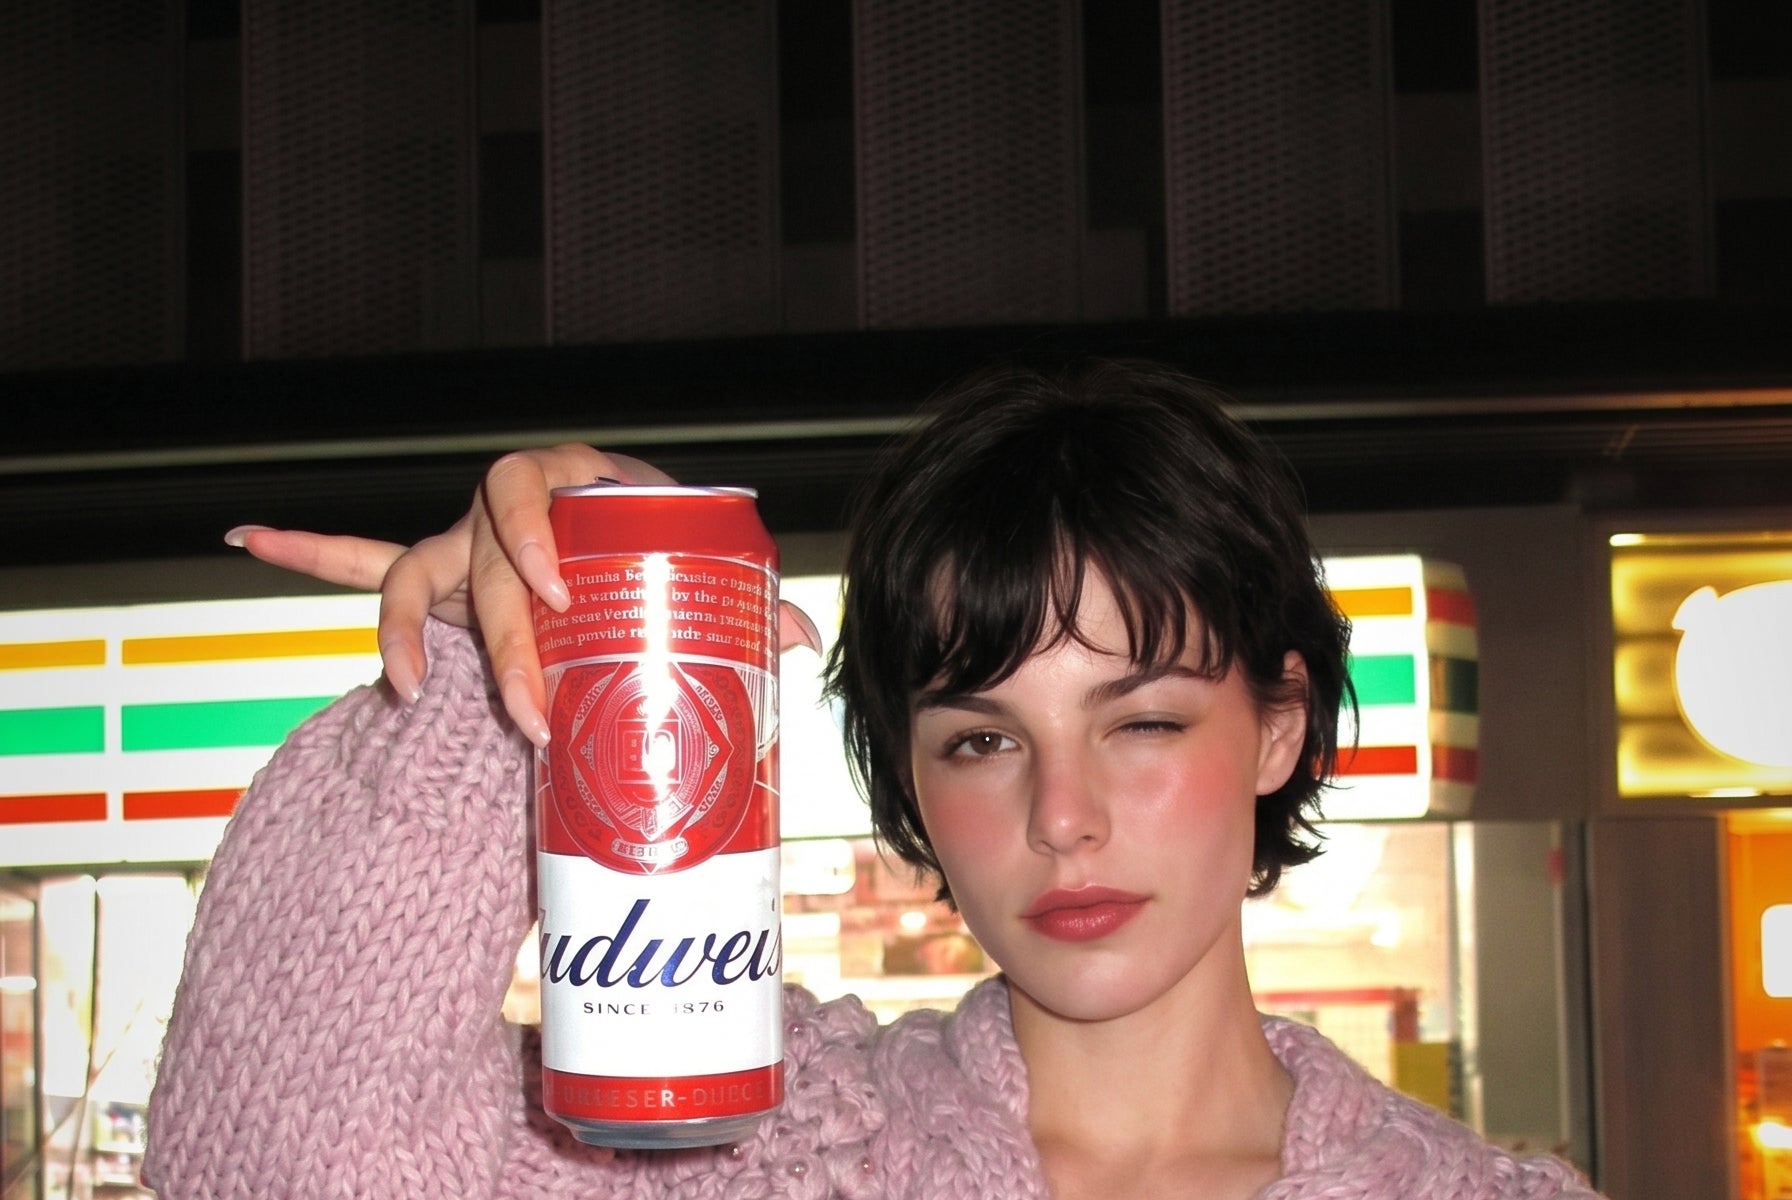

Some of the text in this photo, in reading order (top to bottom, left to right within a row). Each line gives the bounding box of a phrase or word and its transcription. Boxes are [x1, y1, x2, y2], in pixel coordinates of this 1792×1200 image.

[695, 590, 717, 604] the
[538, 898, 782, 988] udweis
[583, 1000, 725, 1015] SINCE 1876
